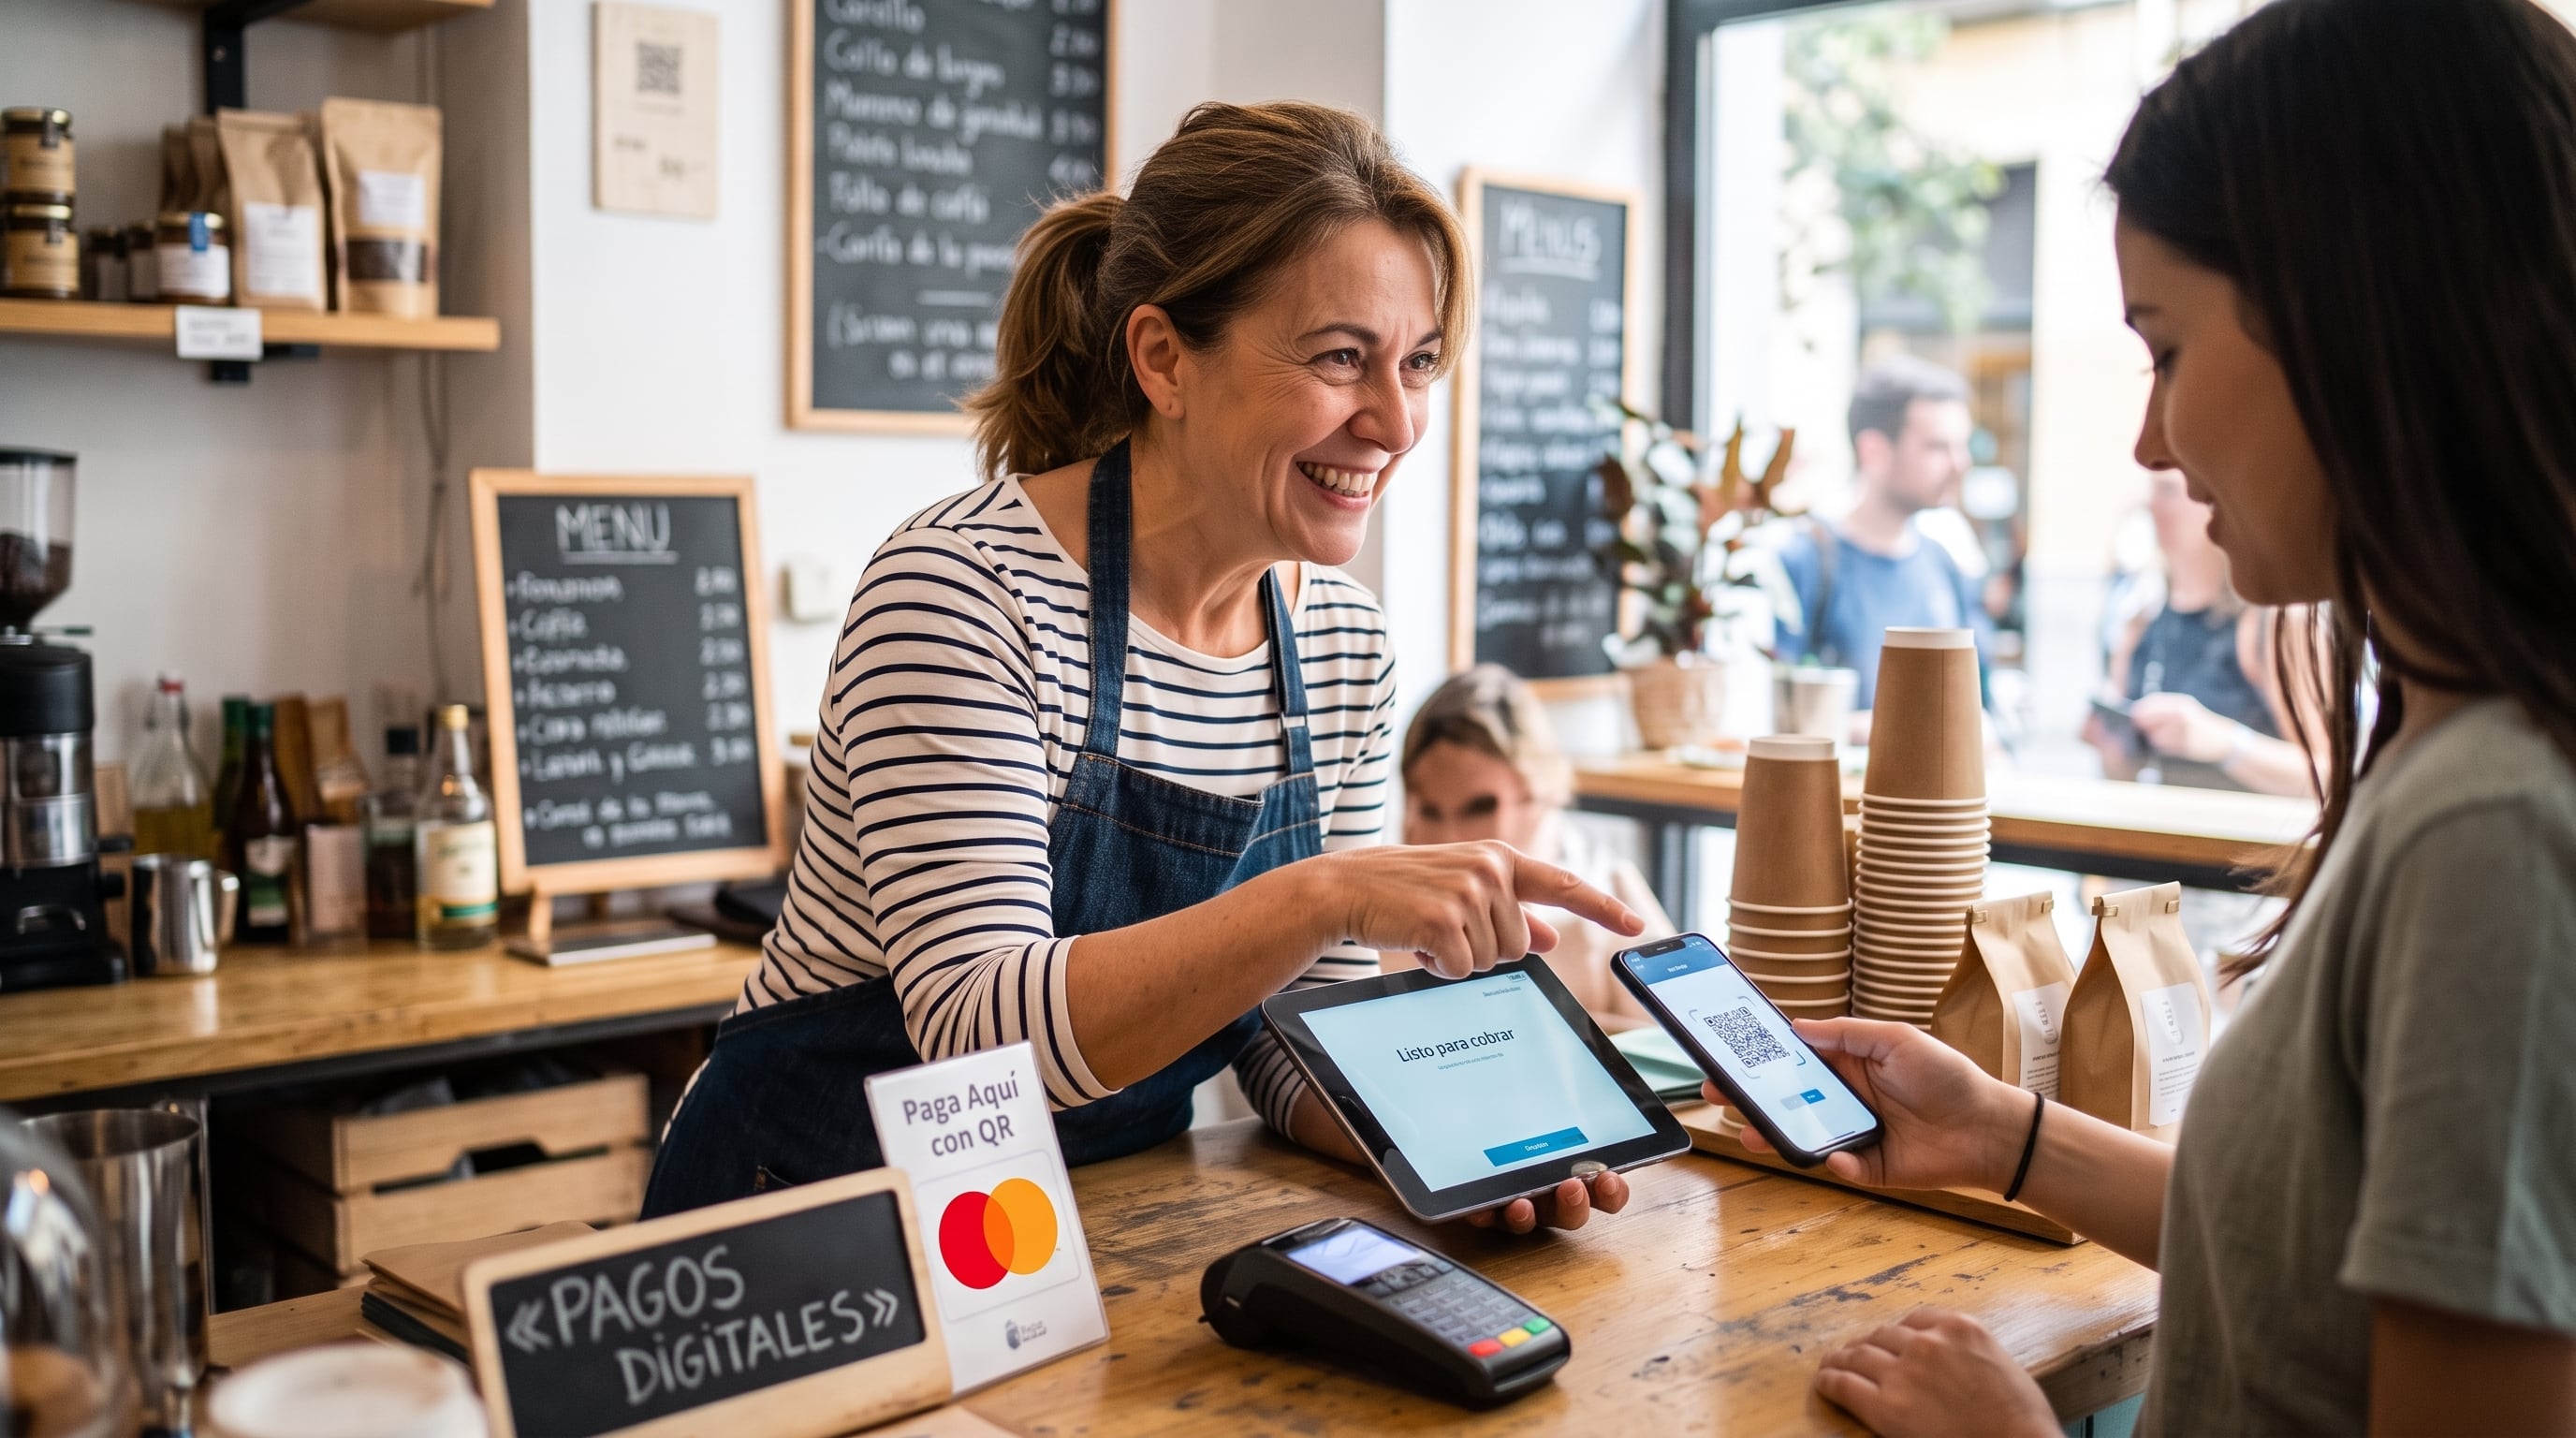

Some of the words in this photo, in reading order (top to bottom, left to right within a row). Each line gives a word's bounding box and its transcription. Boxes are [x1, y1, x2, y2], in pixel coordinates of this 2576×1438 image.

[556, 503, 670, 551] MENU
[1396, 1047, 1435, 1063] Listo
[1435, 1039, 1470, 1057] para
[1470, 1029, 1515, 1047] cobrar
[902, 1094, 961, 1125] Paga
[968, 1071, 1019, 1109] Aquí
[931, 1130, 973, 1156] con
[978, 1114, 1015, 1147] QR
